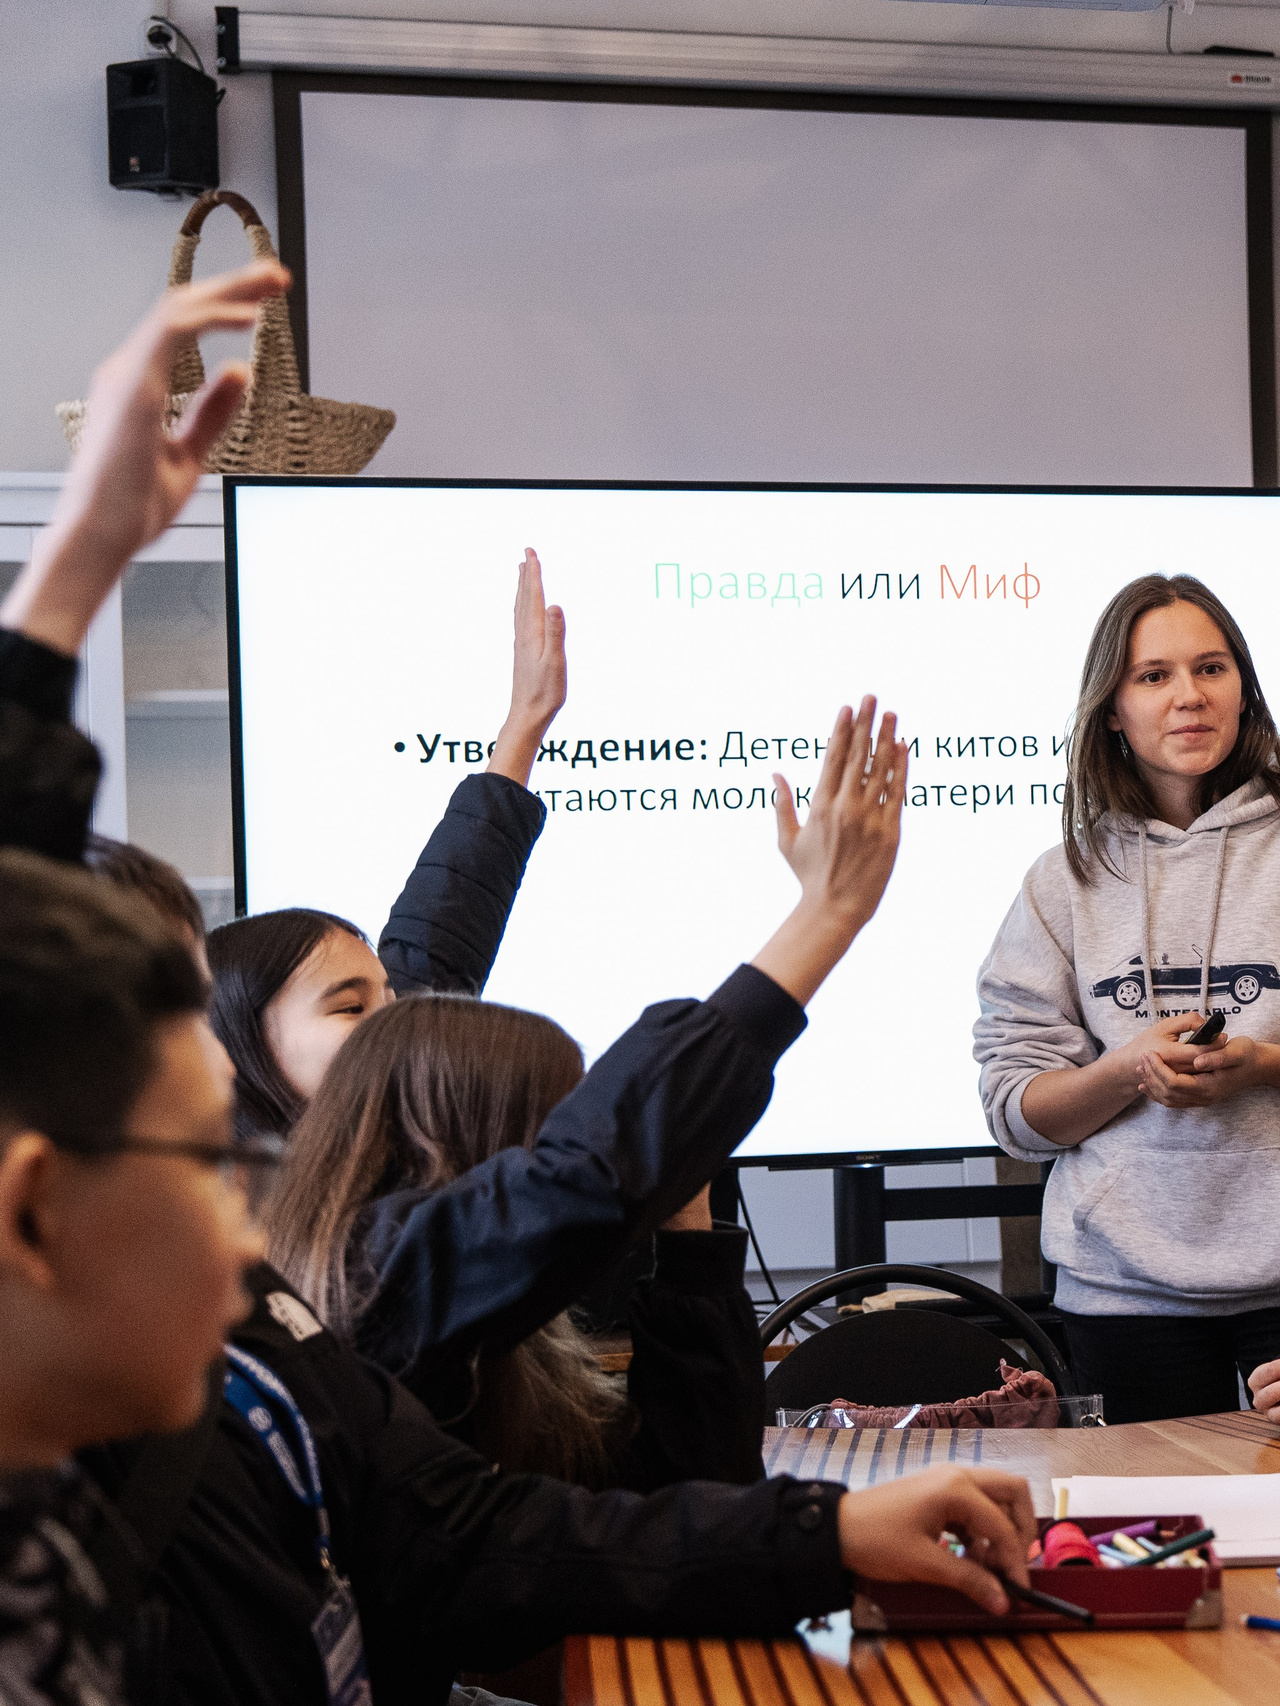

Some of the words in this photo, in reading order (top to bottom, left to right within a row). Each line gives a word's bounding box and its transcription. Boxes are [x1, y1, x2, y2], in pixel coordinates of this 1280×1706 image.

[655, 562, 823, 609] Правда
[841, 572, 920, 600] или
[940, 561, 1041, 609] Миф
[416, 733, 707, 769] Утвждение:
[719, 731, 920, 768] Детени
[936, 735, 1039, 758] китов
[535, 788, 677, 812] таются
[903, 783, 1014, 814] атери
